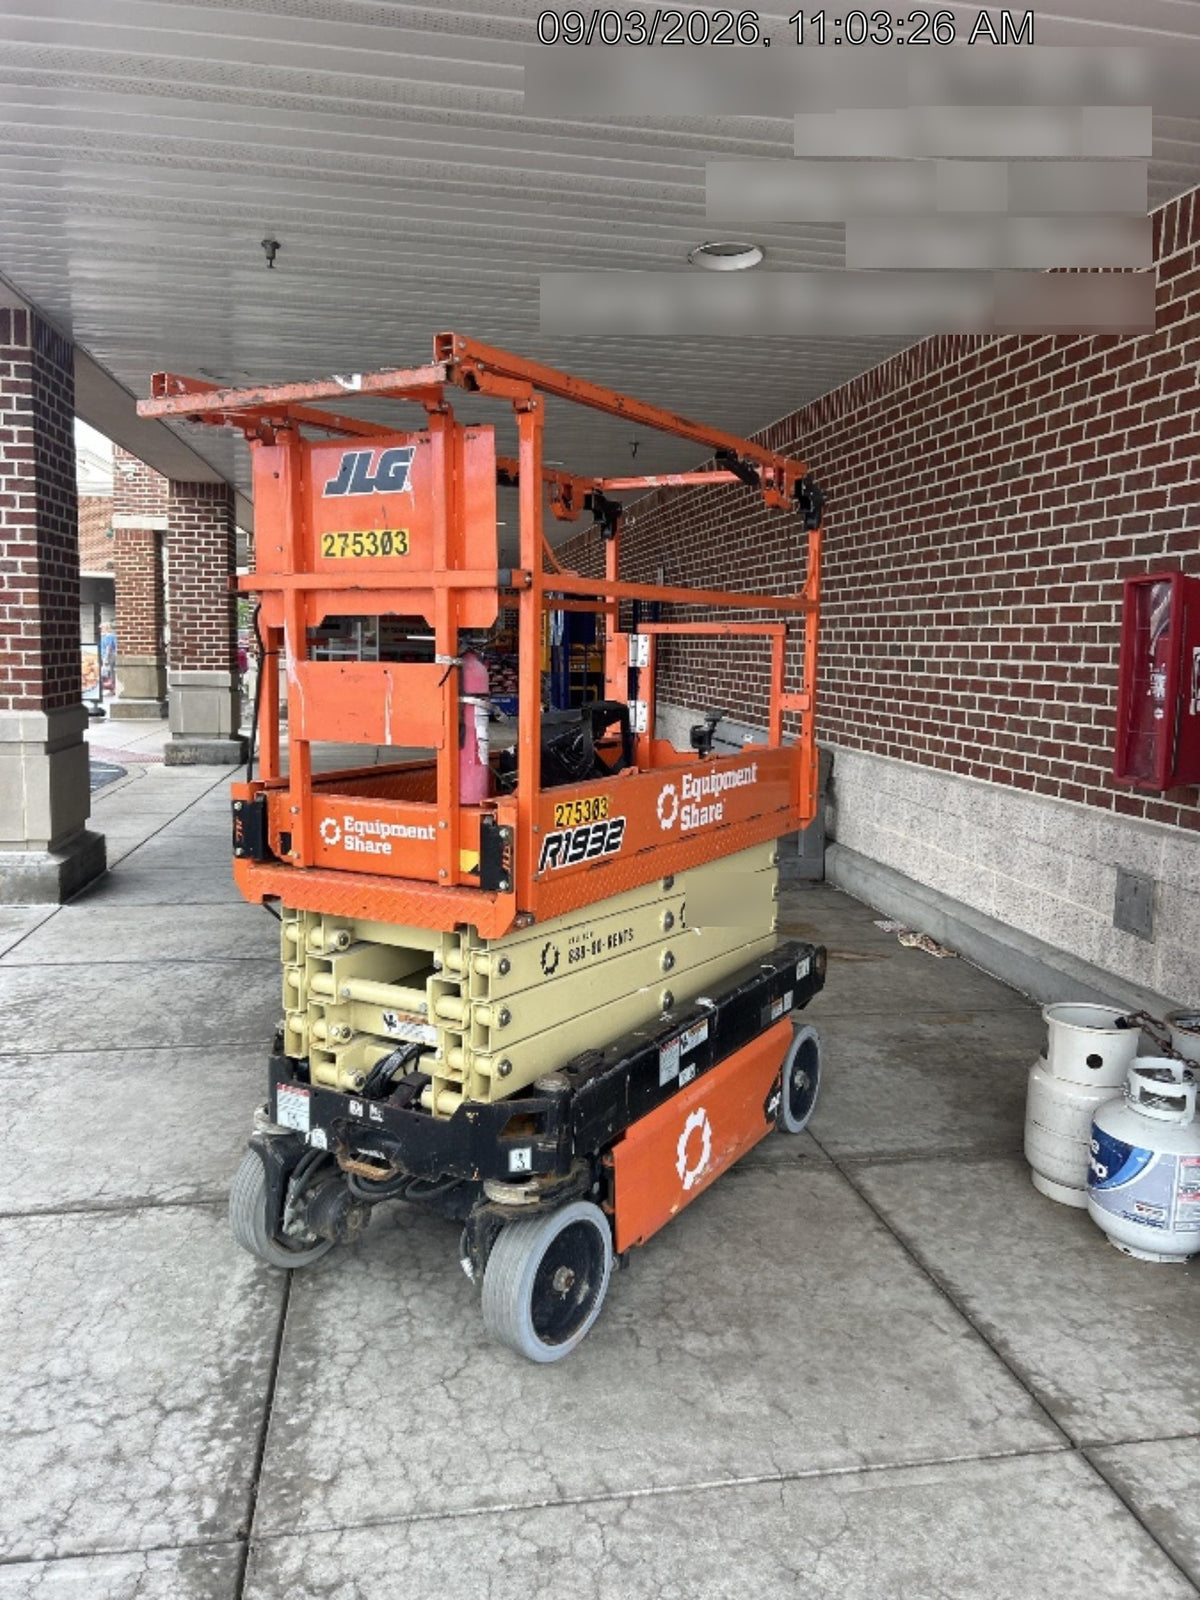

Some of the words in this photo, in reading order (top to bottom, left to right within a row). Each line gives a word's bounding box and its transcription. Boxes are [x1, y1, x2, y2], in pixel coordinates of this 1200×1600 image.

[322, 446, 416, 498] JLG
[322, 530, 409, 558] 275303
[682, 762, 759, 803] Equipment
[343, 815, 436, 841] Equipment
[680, 802, 723, 831] Share
[343, 836, 393, 855] Share
[539, 816, 627, 874] R1932
